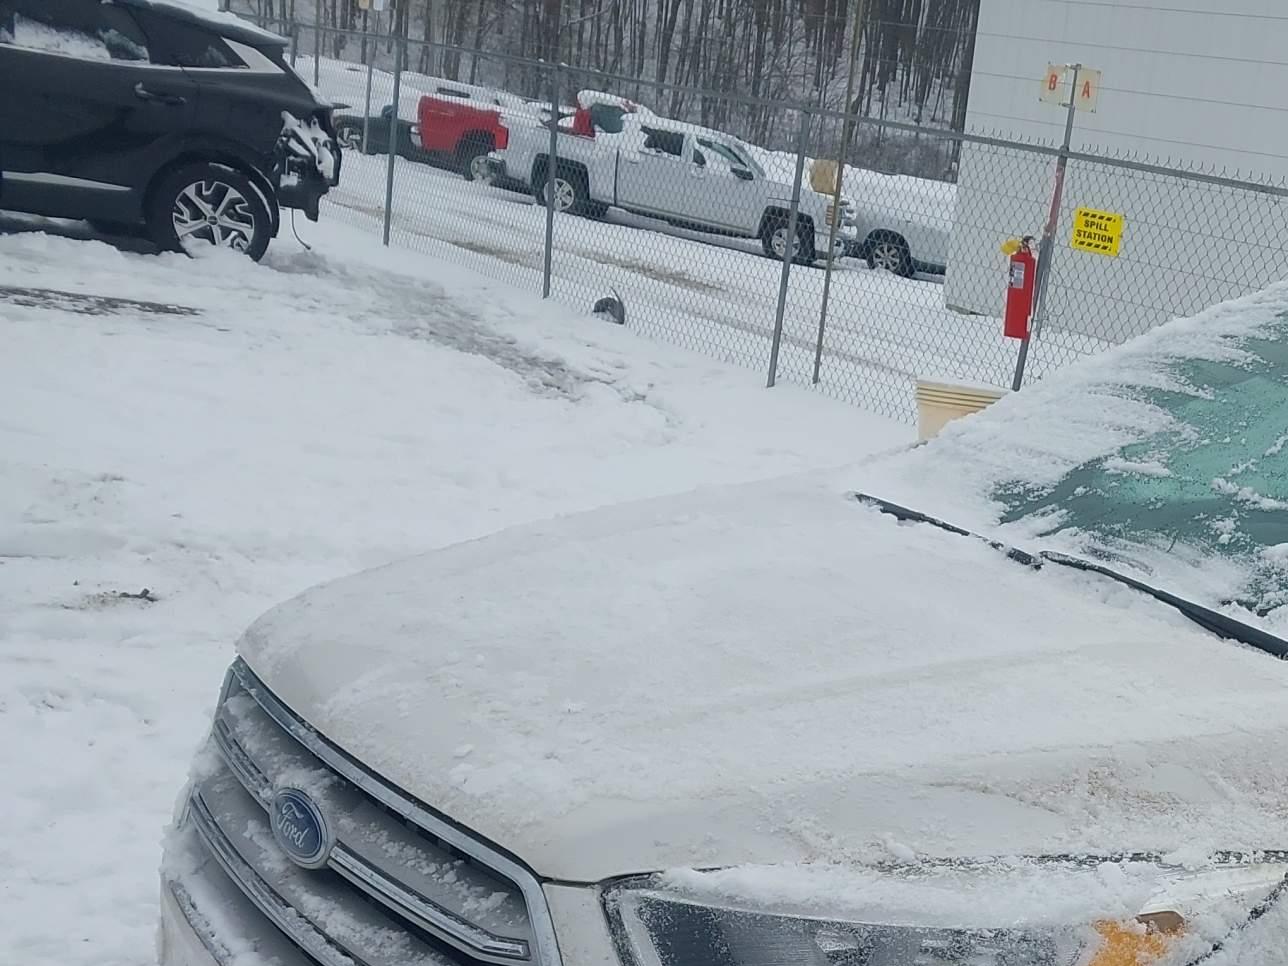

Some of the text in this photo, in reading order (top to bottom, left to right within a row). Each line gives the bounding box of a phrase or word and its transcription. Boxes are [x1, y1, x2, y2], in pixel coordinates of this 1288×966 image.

[1048, 73, 1058, 91] B
[1081, 80, 1090, 99] A
[1083, 219, 1109, 232] SPILL
[1076, 229, 1113, 244] STATION
[277, 801, 310, 849] Ford
